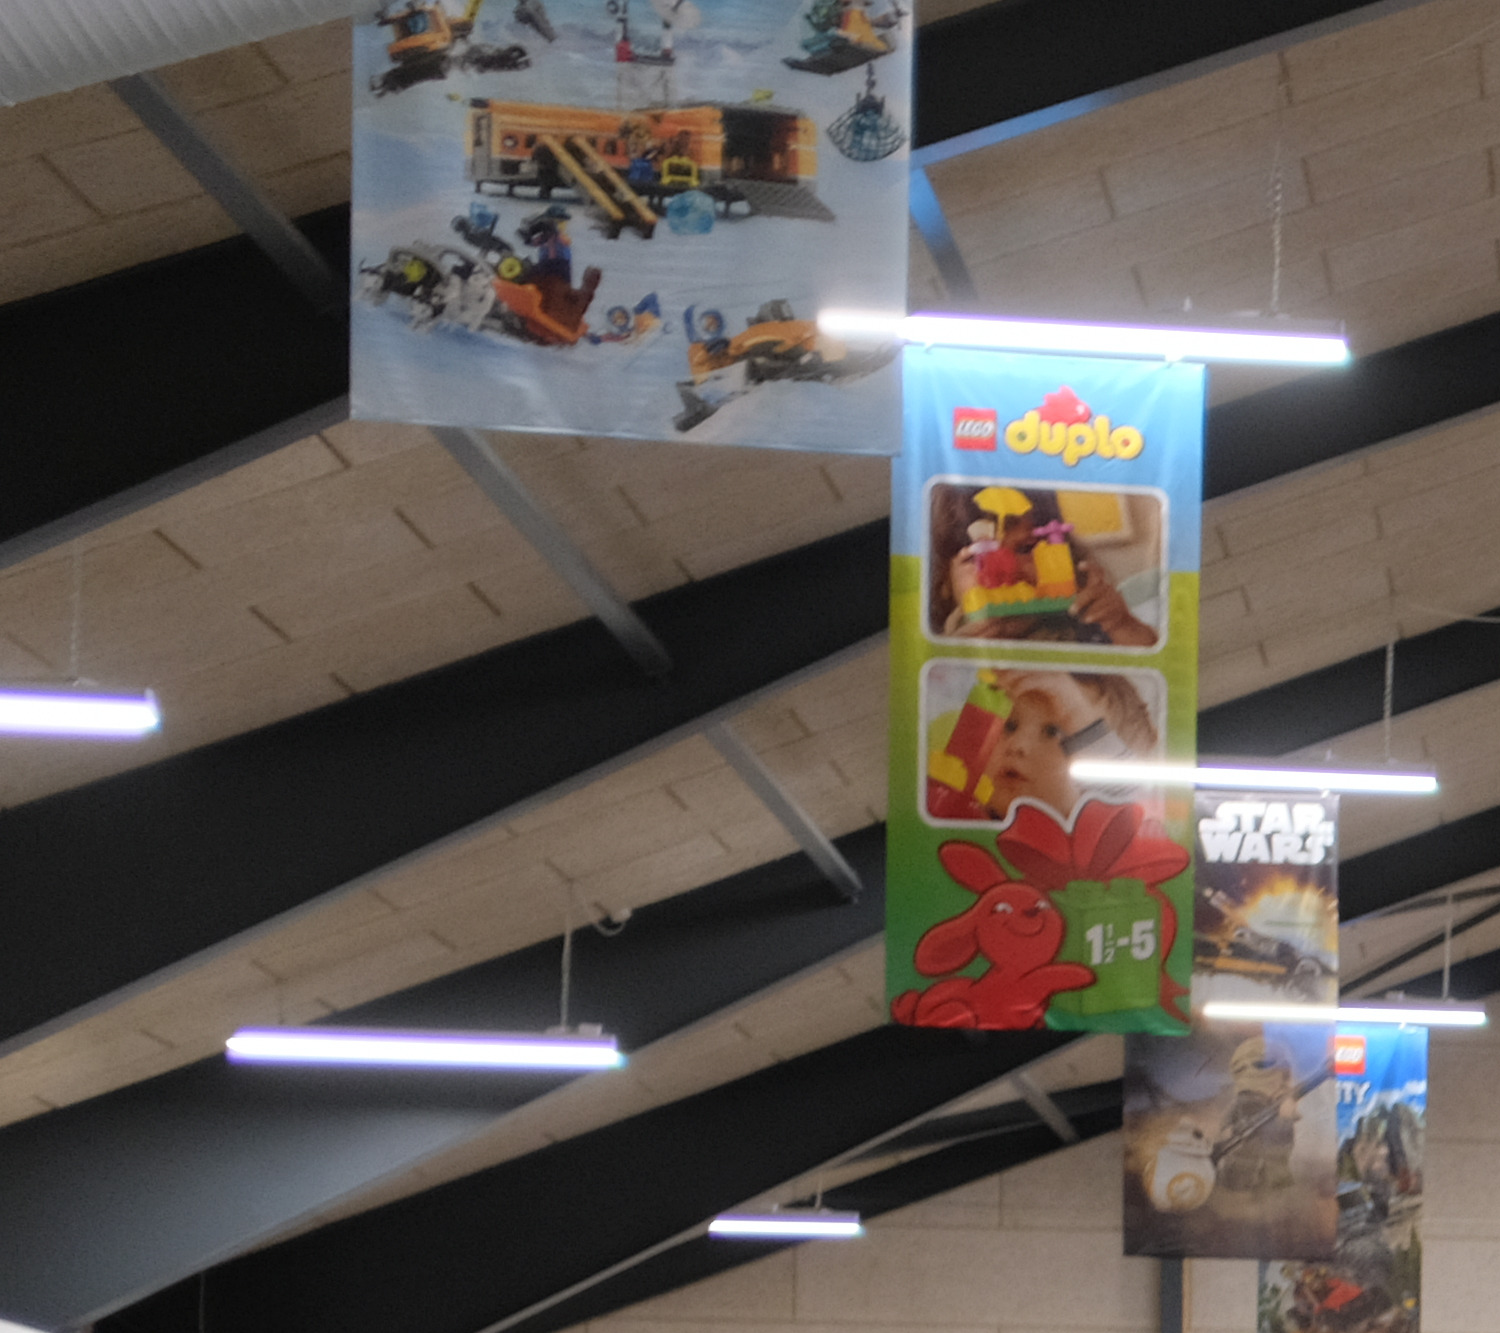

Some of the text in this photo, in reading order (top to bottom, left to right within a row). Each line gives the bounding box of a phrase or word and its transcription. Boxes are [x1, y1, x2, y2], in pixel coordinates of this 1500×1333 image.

[954, 410, 1144, 466] LEGO duplo
[1200, 800, 1334, 832] STAR
[1200, 831, 1334, 865] WARS
